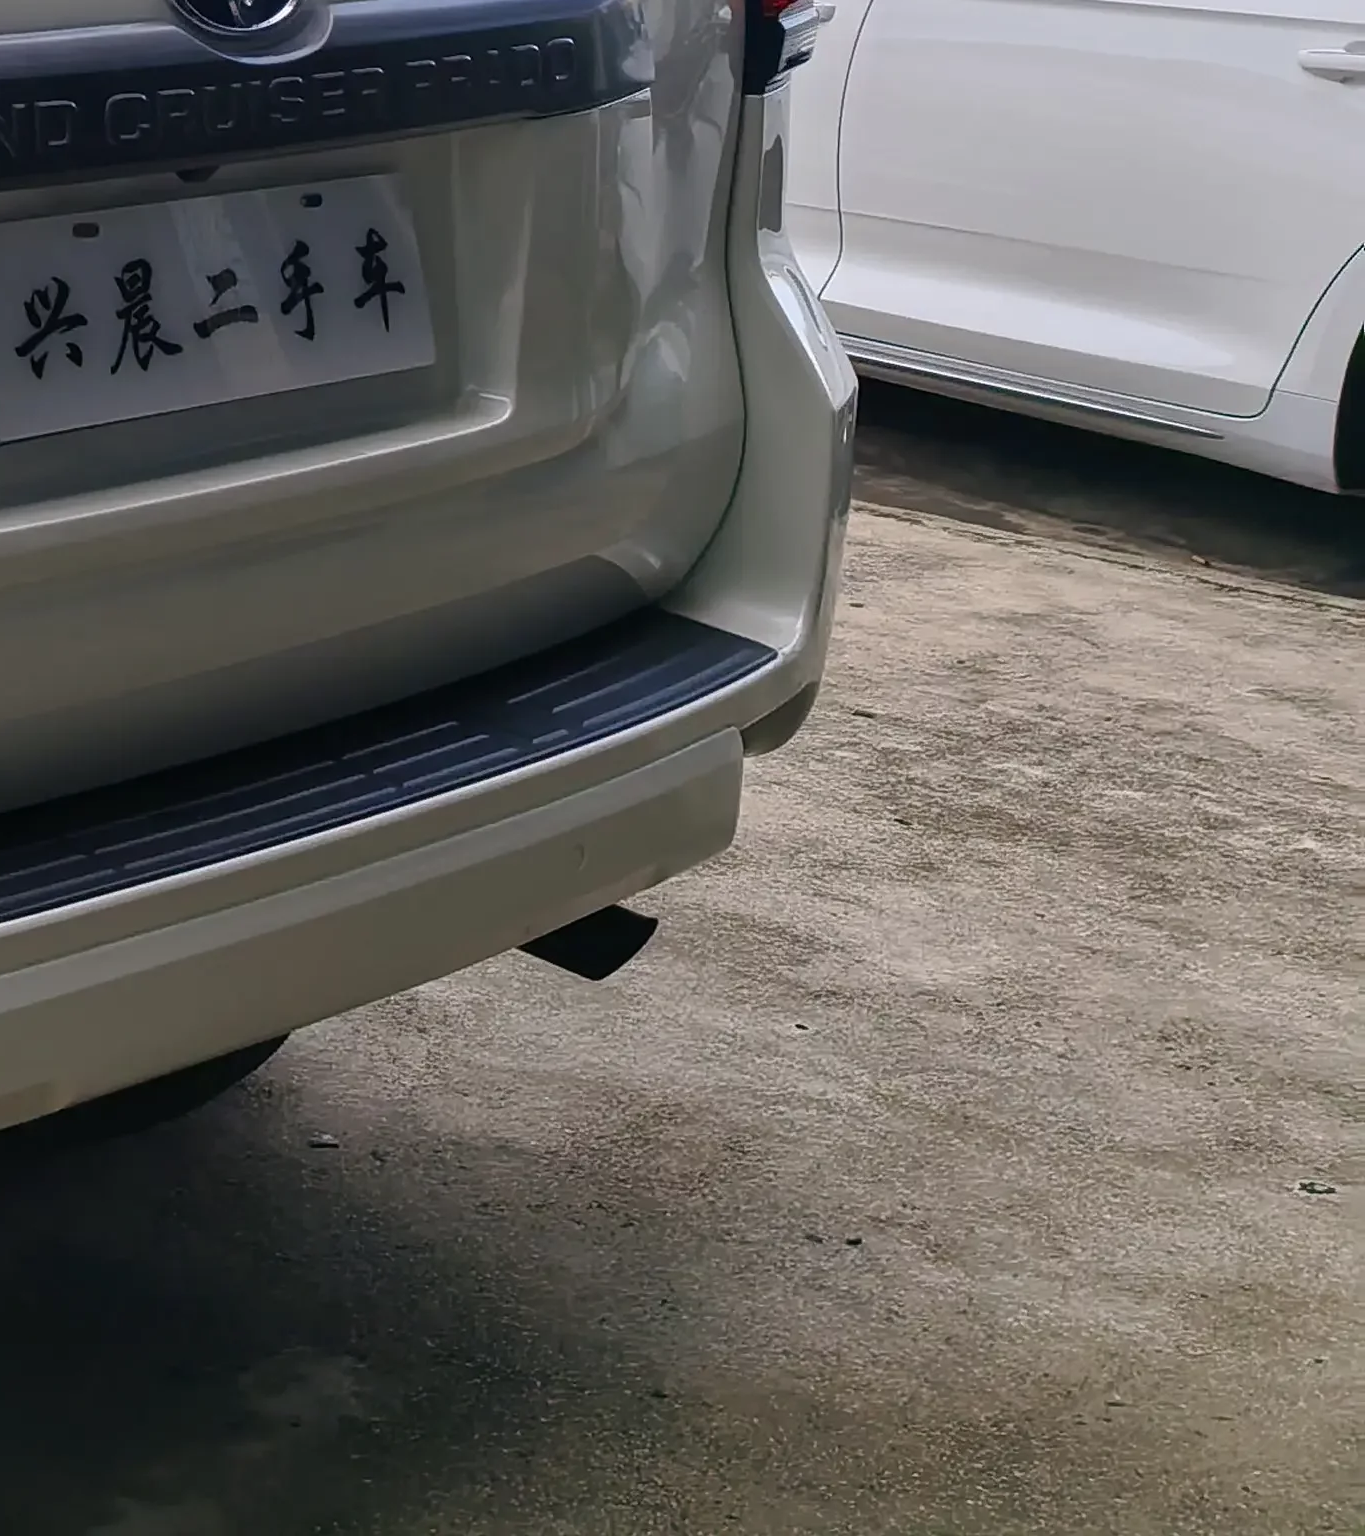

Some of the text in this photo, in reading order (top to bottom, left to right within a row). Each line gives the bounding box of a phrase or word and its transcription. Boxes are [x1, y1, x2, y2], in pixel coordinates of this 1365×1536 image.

[105, 65, 385, 146] CRUISER
[15, 227, 406, 380] 兴晨二手车
